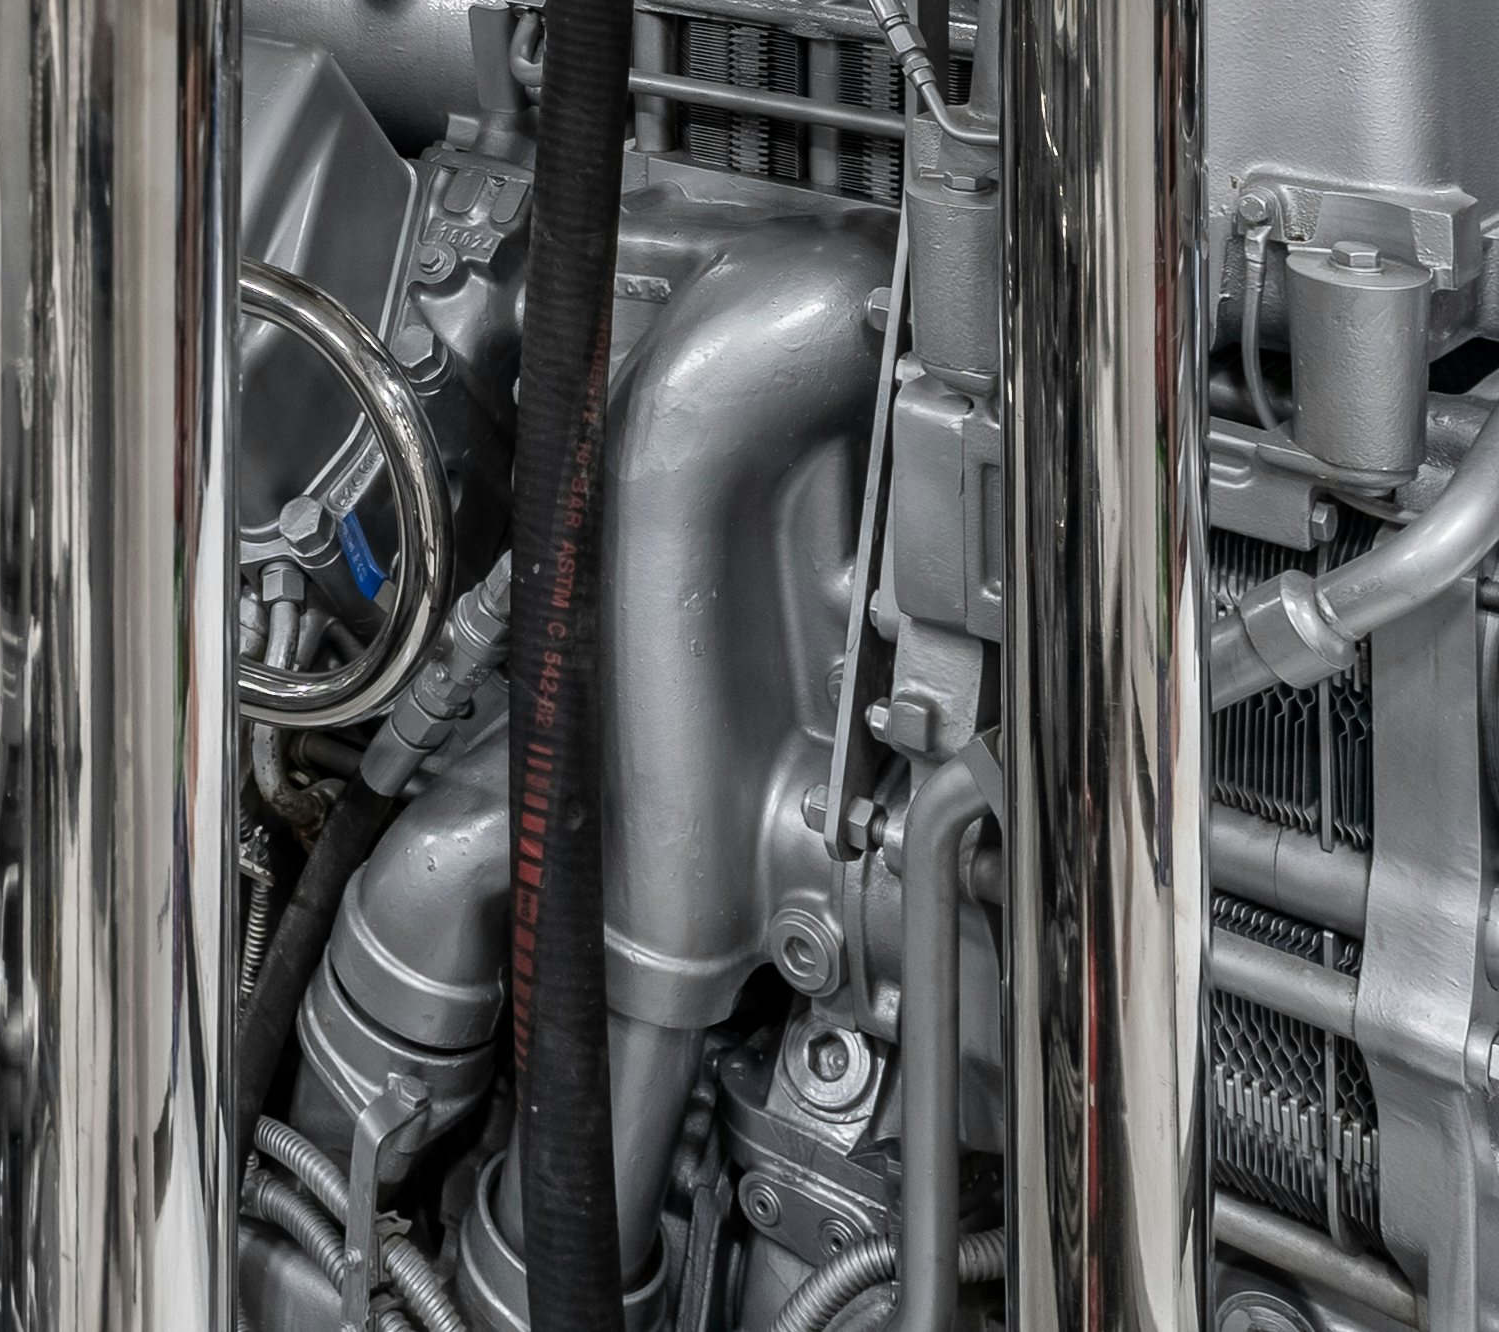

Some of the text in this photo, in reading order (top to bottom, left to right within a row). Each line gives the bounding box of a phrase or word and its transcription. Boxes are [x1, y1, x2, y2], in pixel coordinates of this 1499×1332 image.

[565, 476, 589, 530] BAR
[550, 539, 577, 609] ASTM
[547, 620, 567, 640] C
